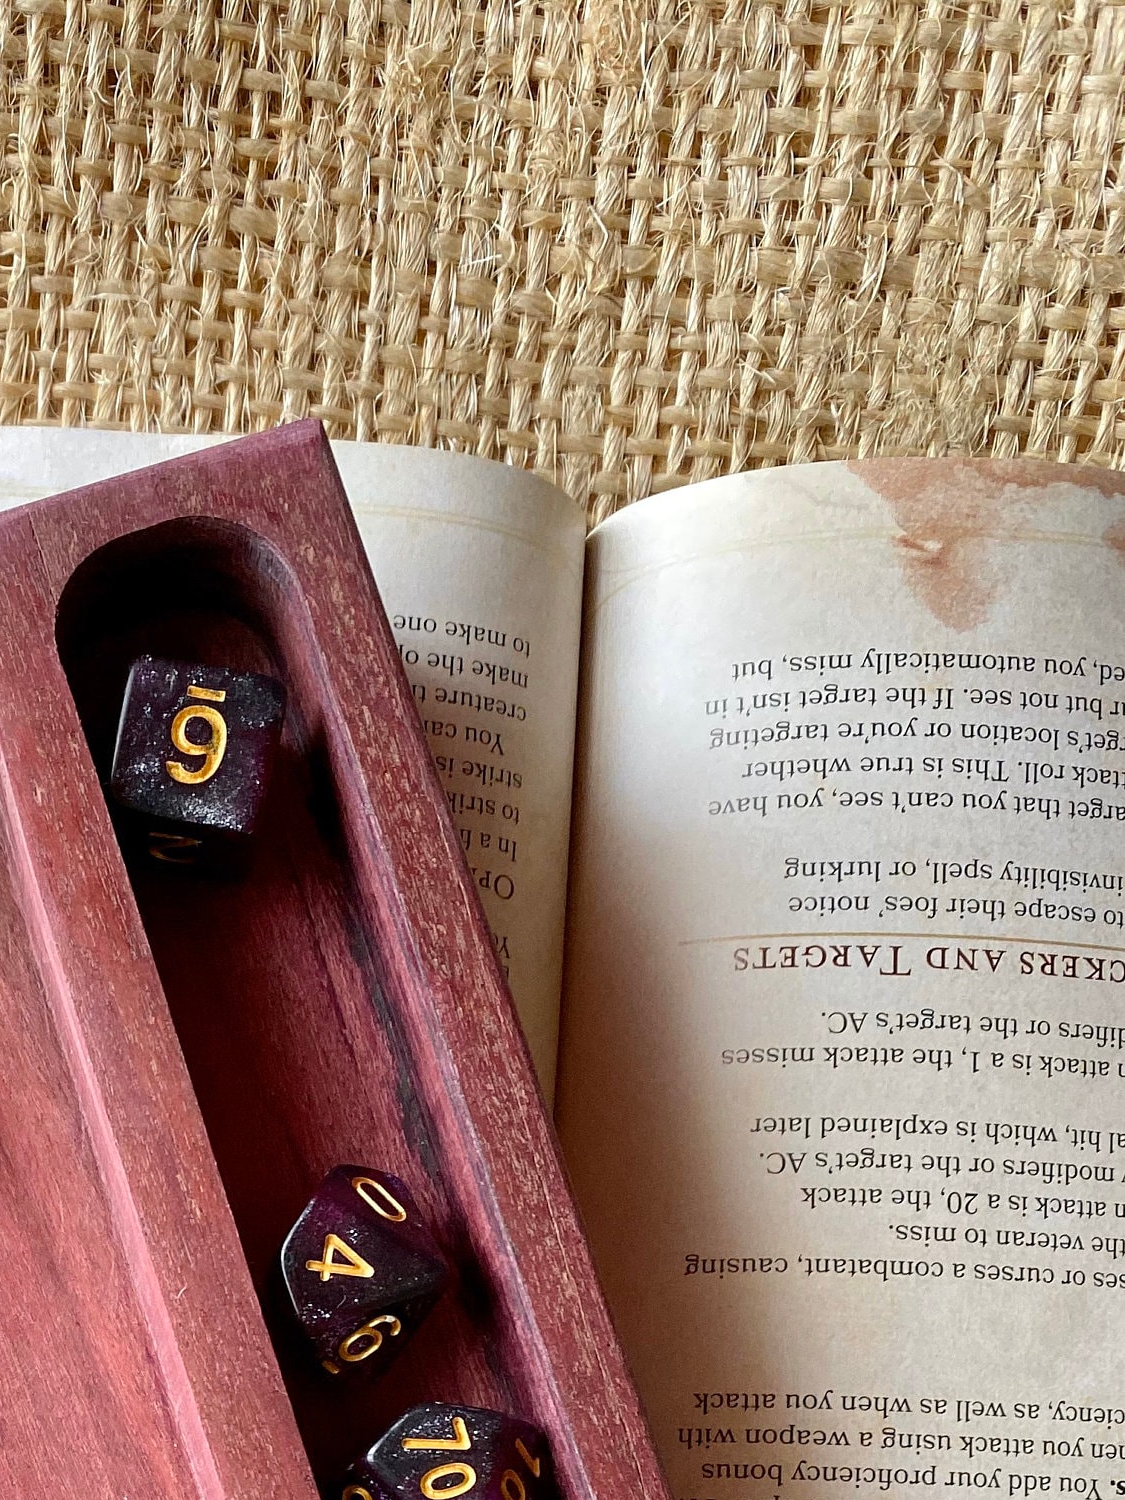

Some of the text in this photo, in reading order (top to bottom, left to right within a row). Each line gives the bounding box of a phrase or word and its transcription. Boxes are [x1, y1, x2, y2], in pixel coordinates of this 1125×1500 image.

[427, 653, 528, 688] make the
[732, 648, 1035, 681] automatically miss, but
[434, 688, 526, 721] creature
[789, 896, 1096, 926] escape their foes' notice
[734, 945, 1007, 976] AND TARGETS
[760, 1148, 913, 1174] target's AC.
[352, 1177, 406, 1222] 0
[941, 1187, 978, 1215] 20,
[889, 1225, 1084, 1252] veteran to miss.
[305, 1234, 375, 1281] 4
[681, 1251, 1054, 1283] curses a combatant, causing
[402, 1417, 476, 1500] 70
[788, 1460, 1103, 1500] You add your proficiency
